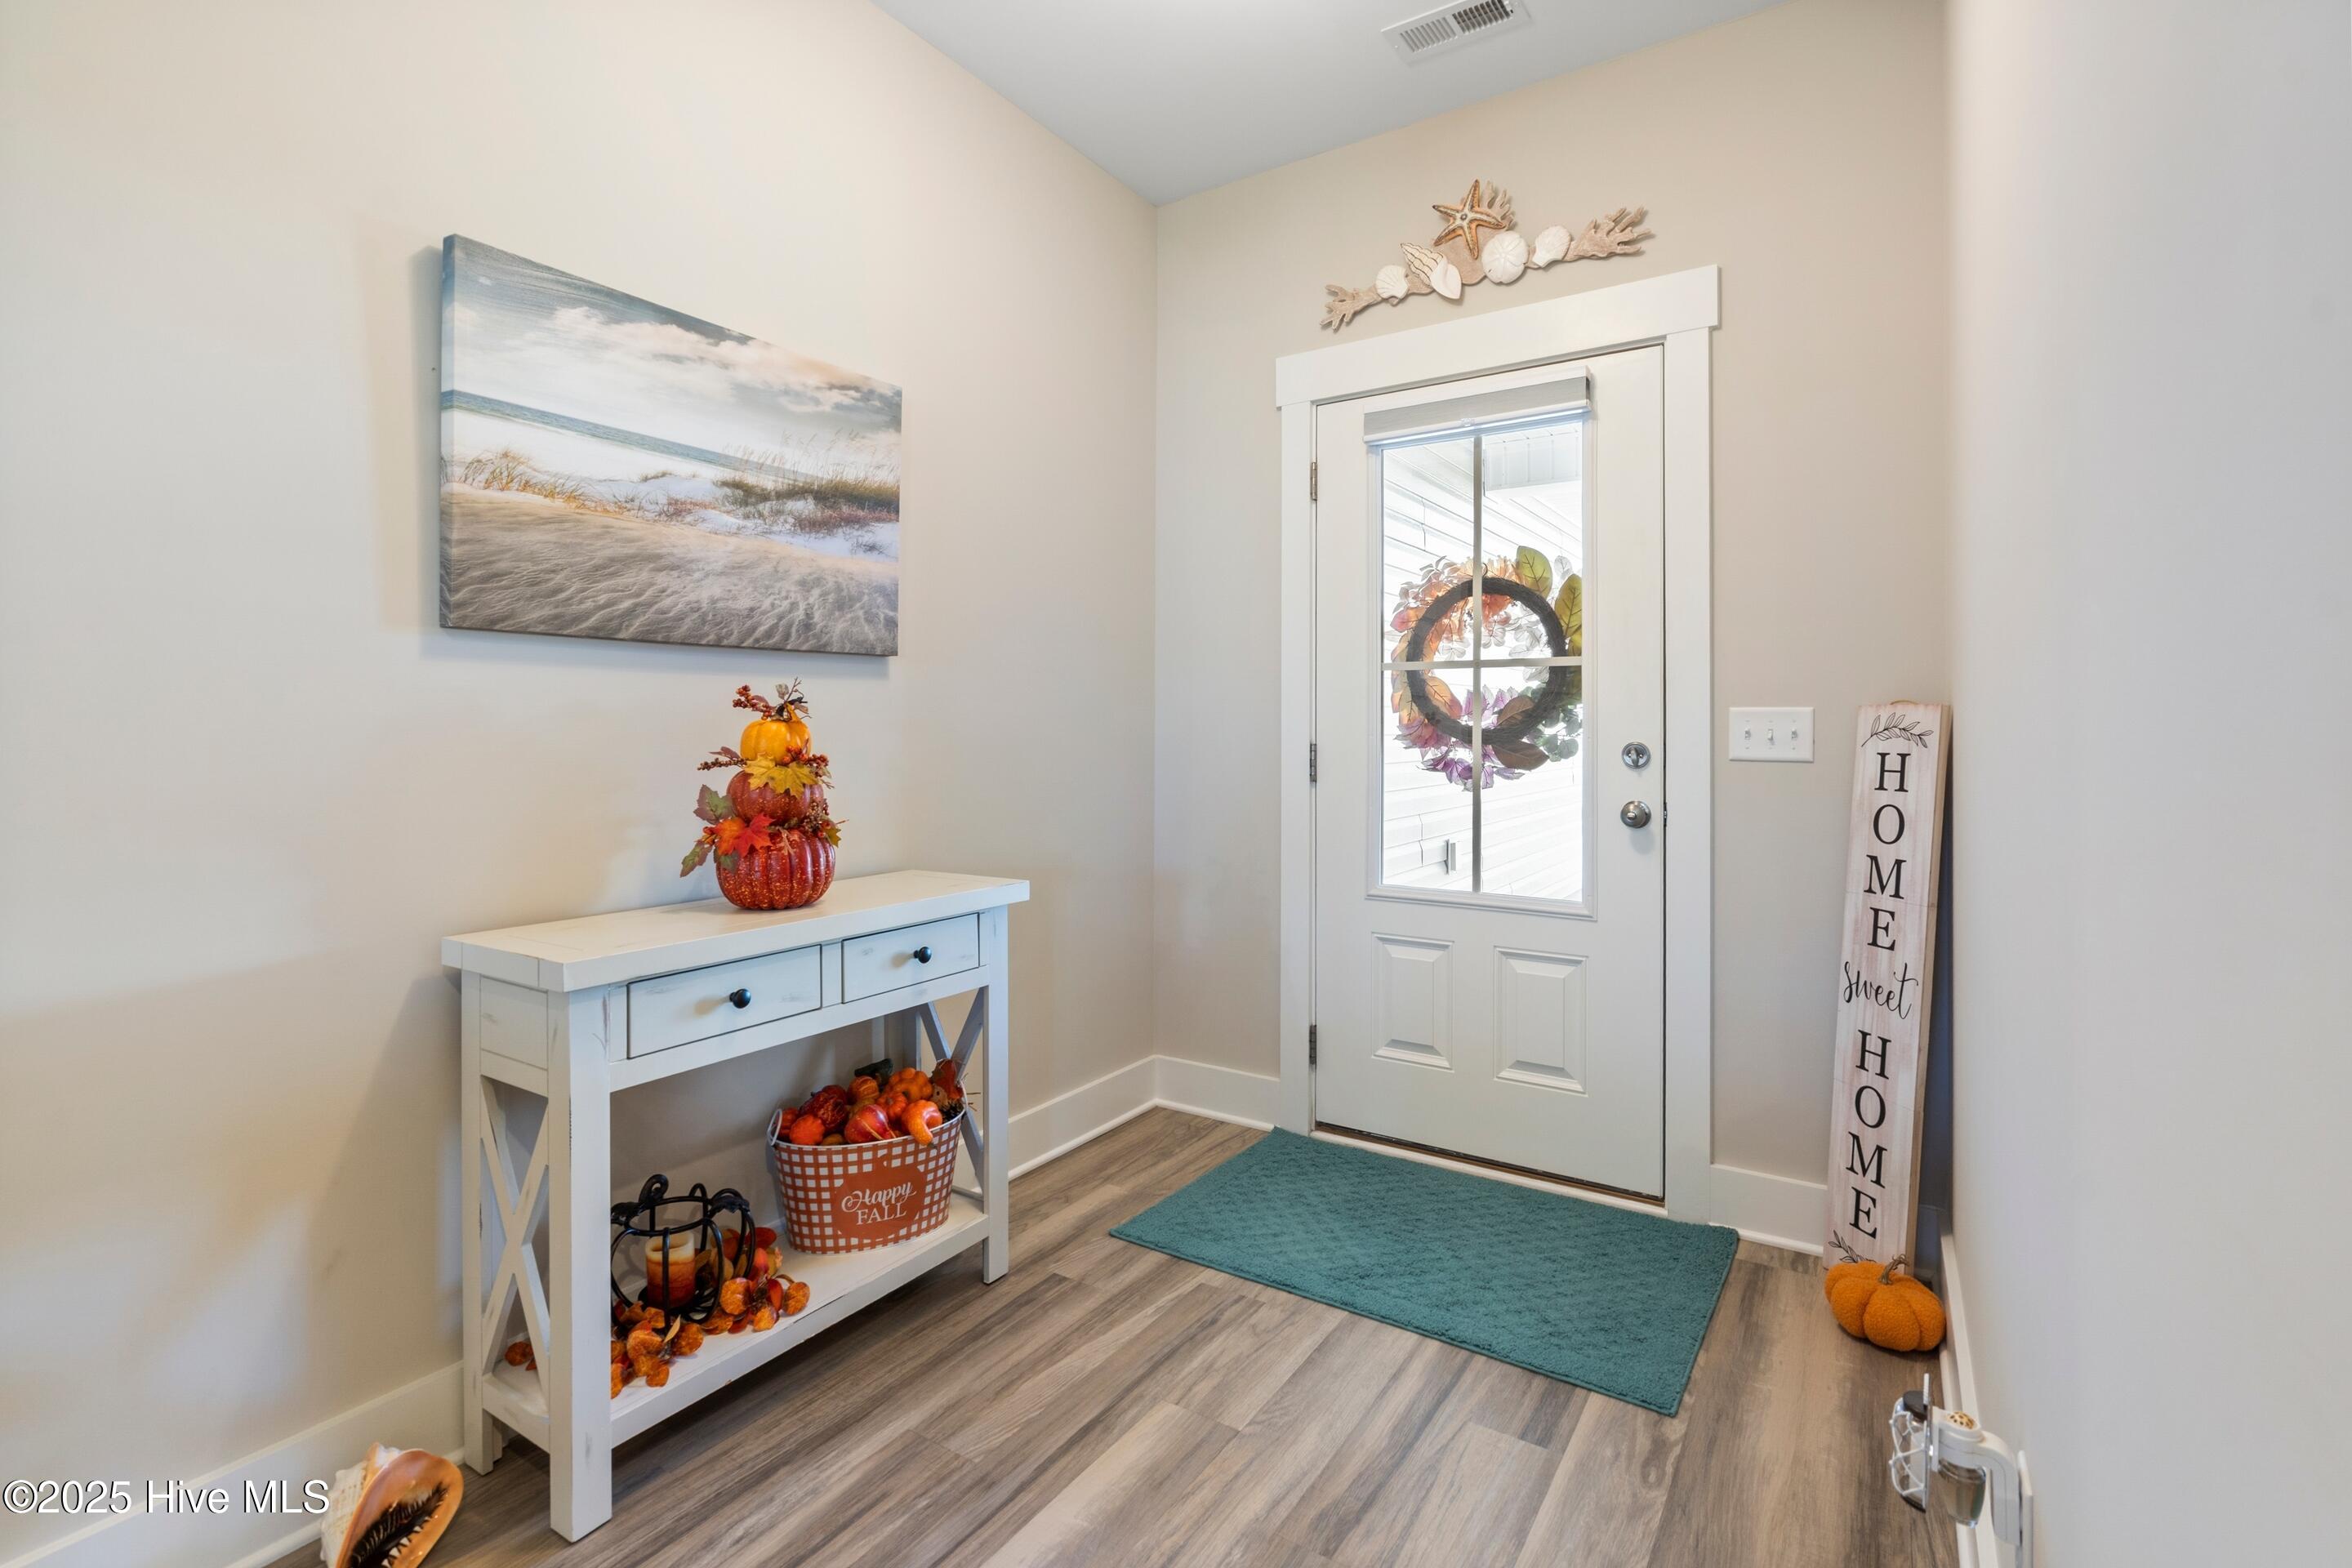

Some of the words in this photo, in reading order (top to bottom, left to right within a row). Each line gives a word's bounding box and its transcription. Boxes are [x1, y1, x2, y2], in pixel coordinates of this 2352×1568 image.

[1863, 751, 1912, 952] HOME
[1842, 960, 1919, 1020] sweet
[1845, 1029, 1892, 1240] HOME
[841, 1182, 916, 1213] Happy
[856, 1202, 907, 1225] FALL
